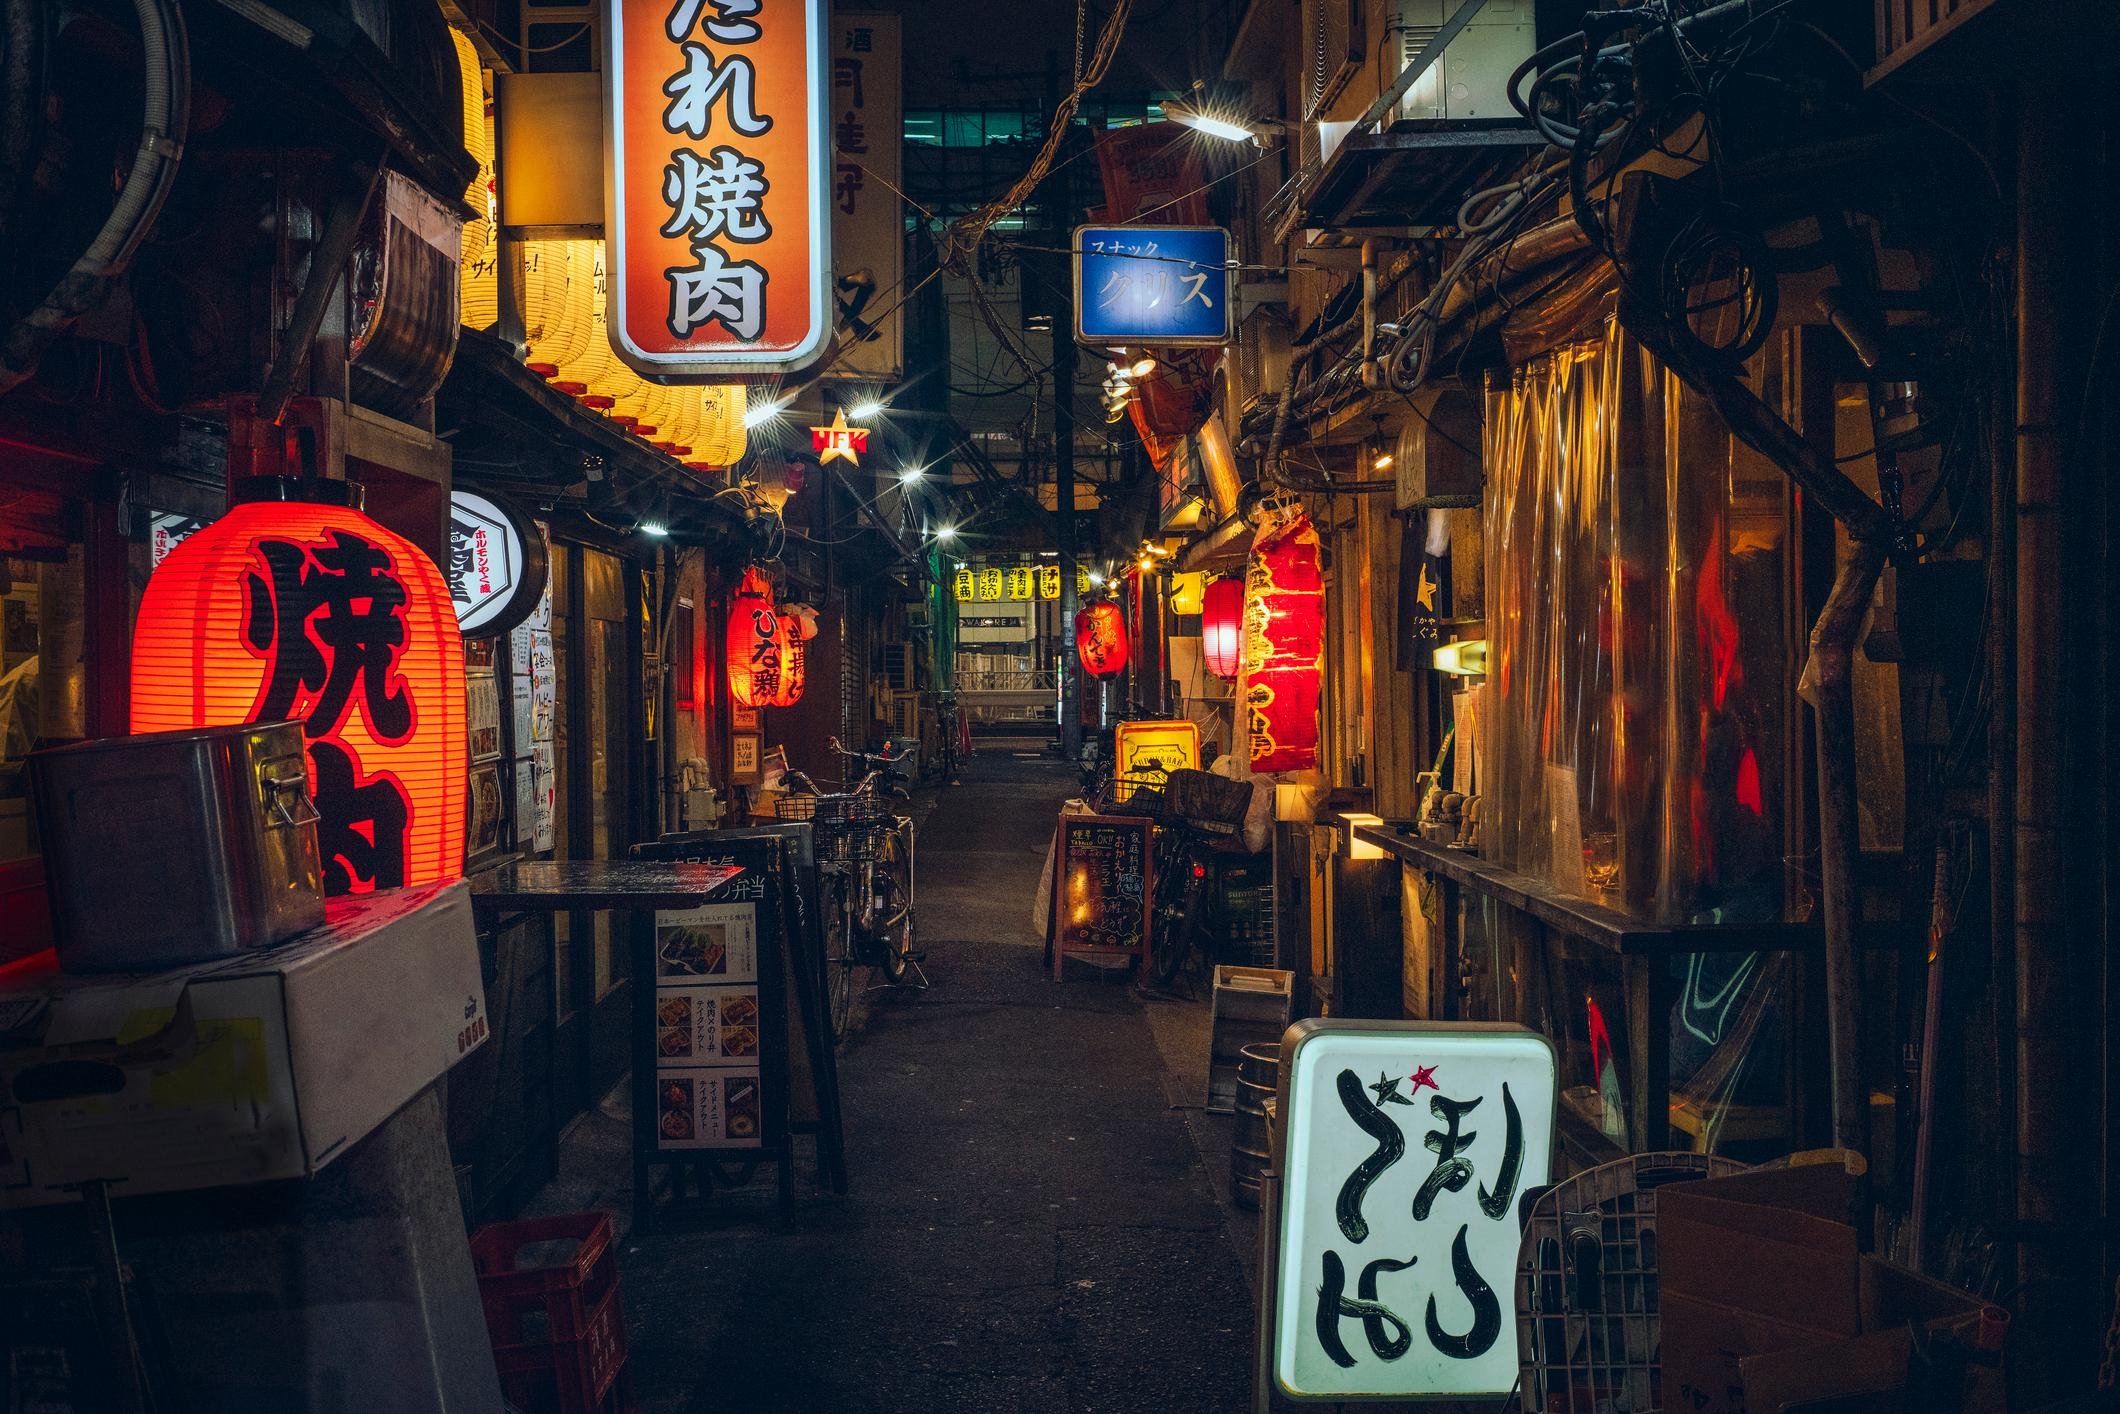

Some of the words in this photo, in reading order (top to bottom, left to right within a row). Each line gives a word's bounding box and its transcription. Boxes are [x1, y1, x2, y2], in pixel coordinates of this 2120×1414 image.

[1091, 241, 1158, 257] スナック
[1099, 271, 1213, 309] クリス
[752, 608, 781, 698] ひな鶏
[246, 531, 413, 893] 焼肉
